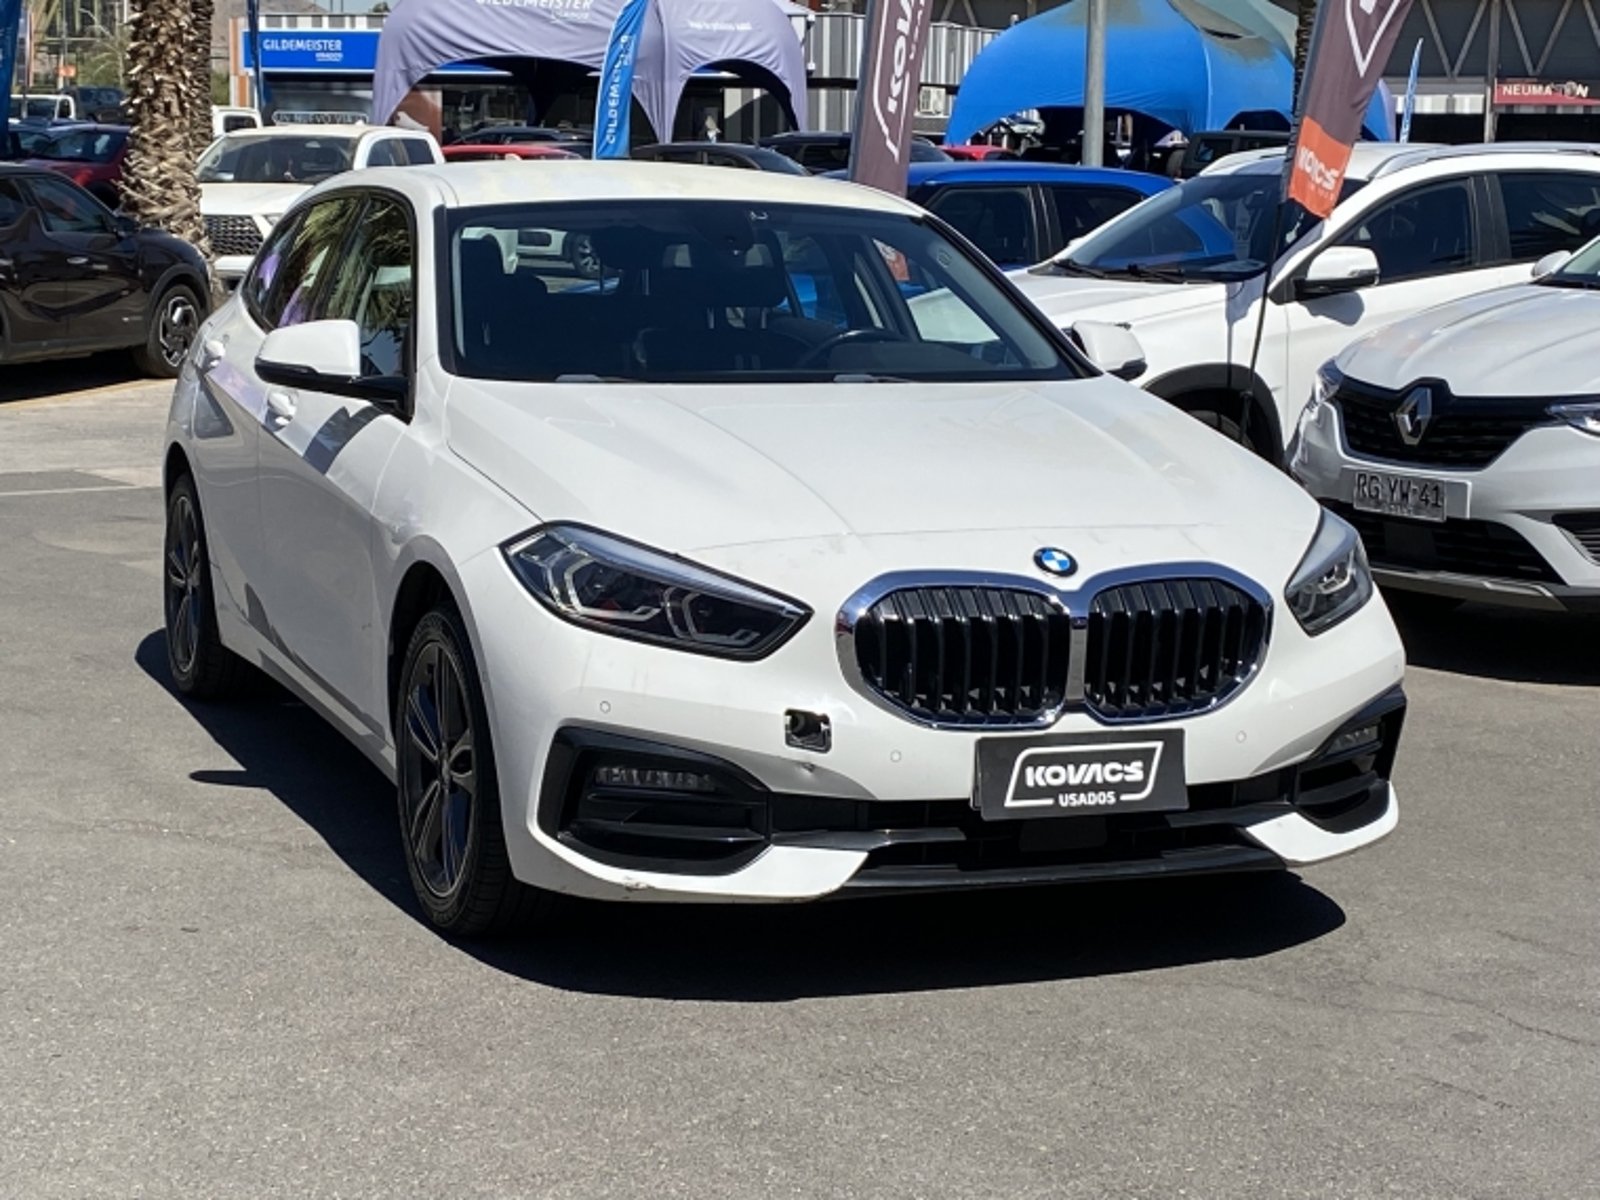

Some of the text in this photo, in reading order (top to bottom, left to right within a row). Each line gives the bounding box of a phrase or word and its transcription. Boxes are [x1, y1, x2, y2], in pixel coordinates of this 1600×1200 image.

[262, 39, 342, 51] GILDEMEISTER
[1025, 760, 1144, 787] KOVACS
[1058, 791, 1116, 807] USADOS
